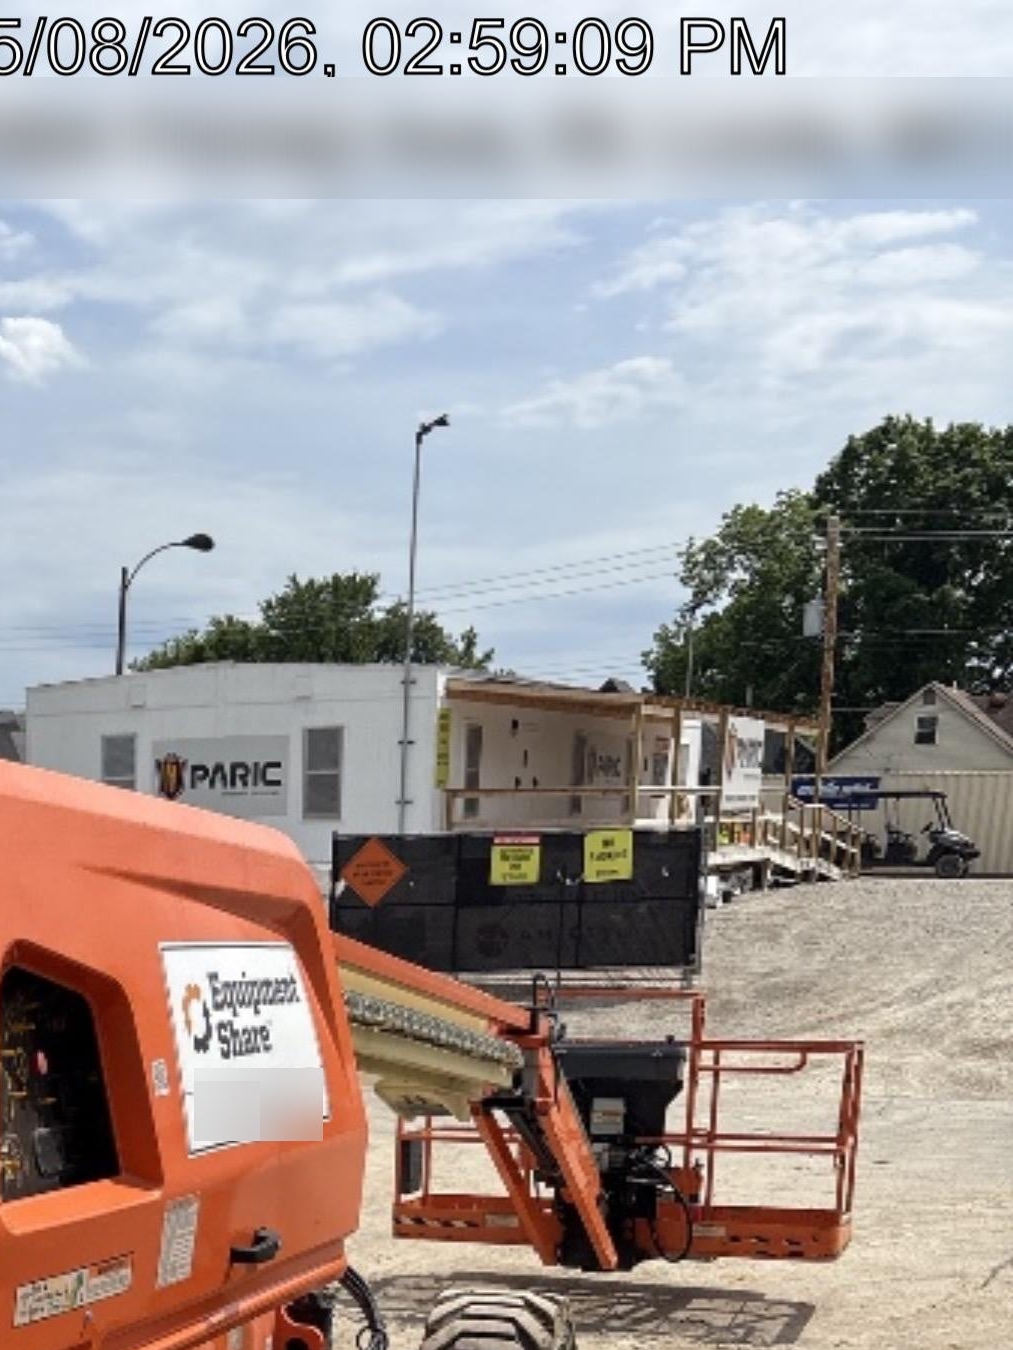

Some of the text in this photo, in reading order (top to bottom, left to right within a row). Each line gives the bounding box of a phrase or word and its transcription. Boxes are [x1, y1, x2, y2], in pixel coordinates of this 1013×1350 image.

[190, 762, 282, 789] PARIC
[207, 971, 300, 1017] Equipment
[217, 1019, 274, 1060] Share
